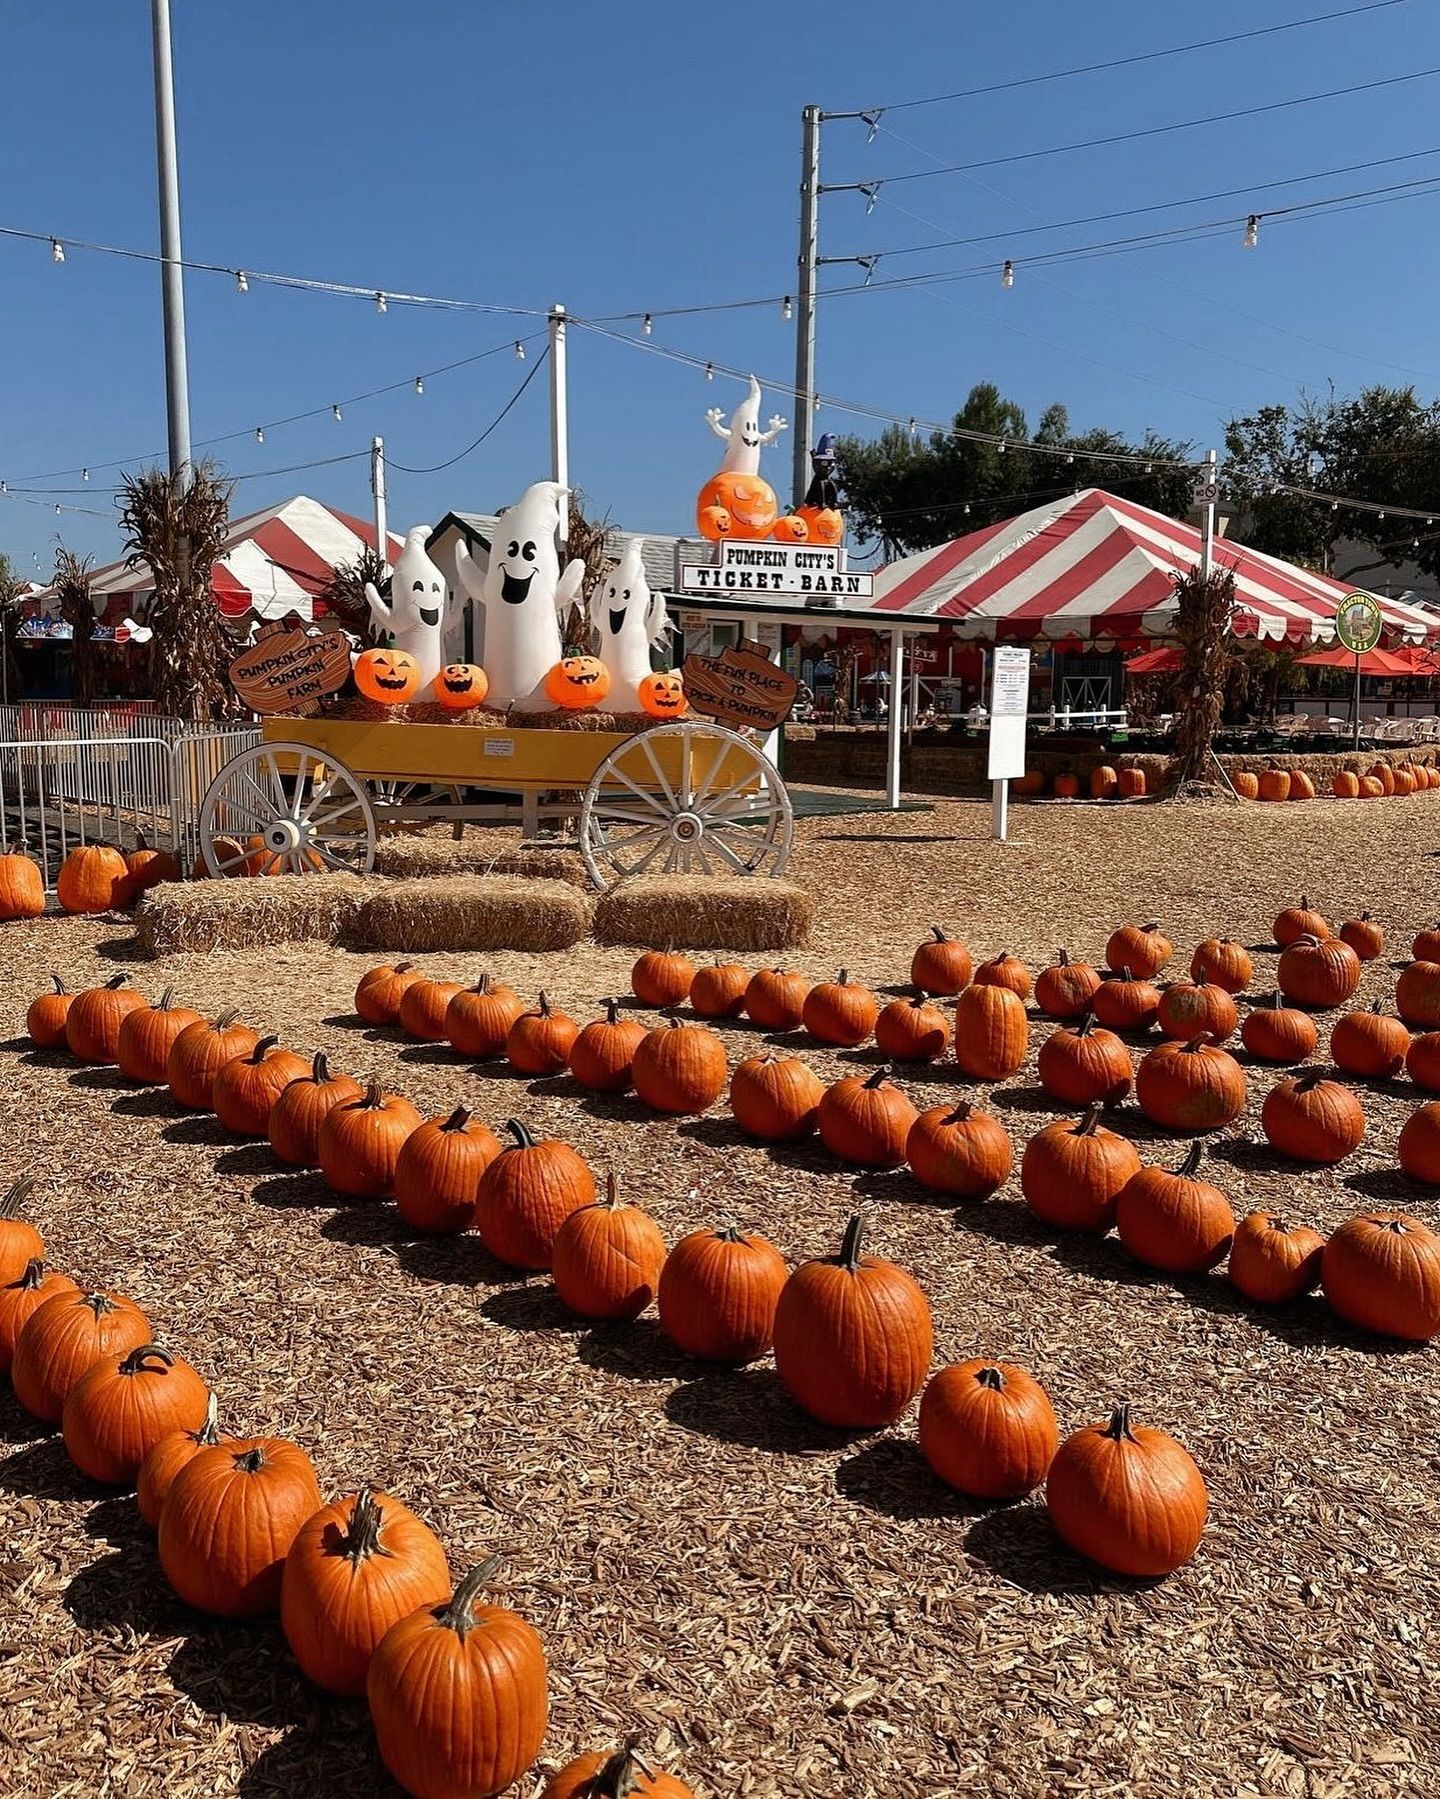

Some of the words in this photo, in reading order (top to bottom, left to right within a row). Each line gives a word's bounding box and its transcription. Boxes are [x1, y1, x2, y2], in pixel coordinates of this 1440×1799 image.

[727, 548, 788, 567] PUMPKIN
[795, 552, 835, 570] CITY'S
[697, 569, 784, 589] TICKET
[801, 575, 861, 593] BARN
[237, 650, 297, 679] PUMPKIN
[297, 637, 338, 660] CITY'S
[267, 660, 326, 687] PUMPKIN
[701, 659, 726, 675] THE
[726, 665, 747, 681] FUN
[748, 671, 785, 691] PLACE
[287, 681, 322, 700] FARM
[729, 684, 746, 696] TO
[688, 687, 716, 704] PICK
[727, 699, 778, 722] PUMPKIN
